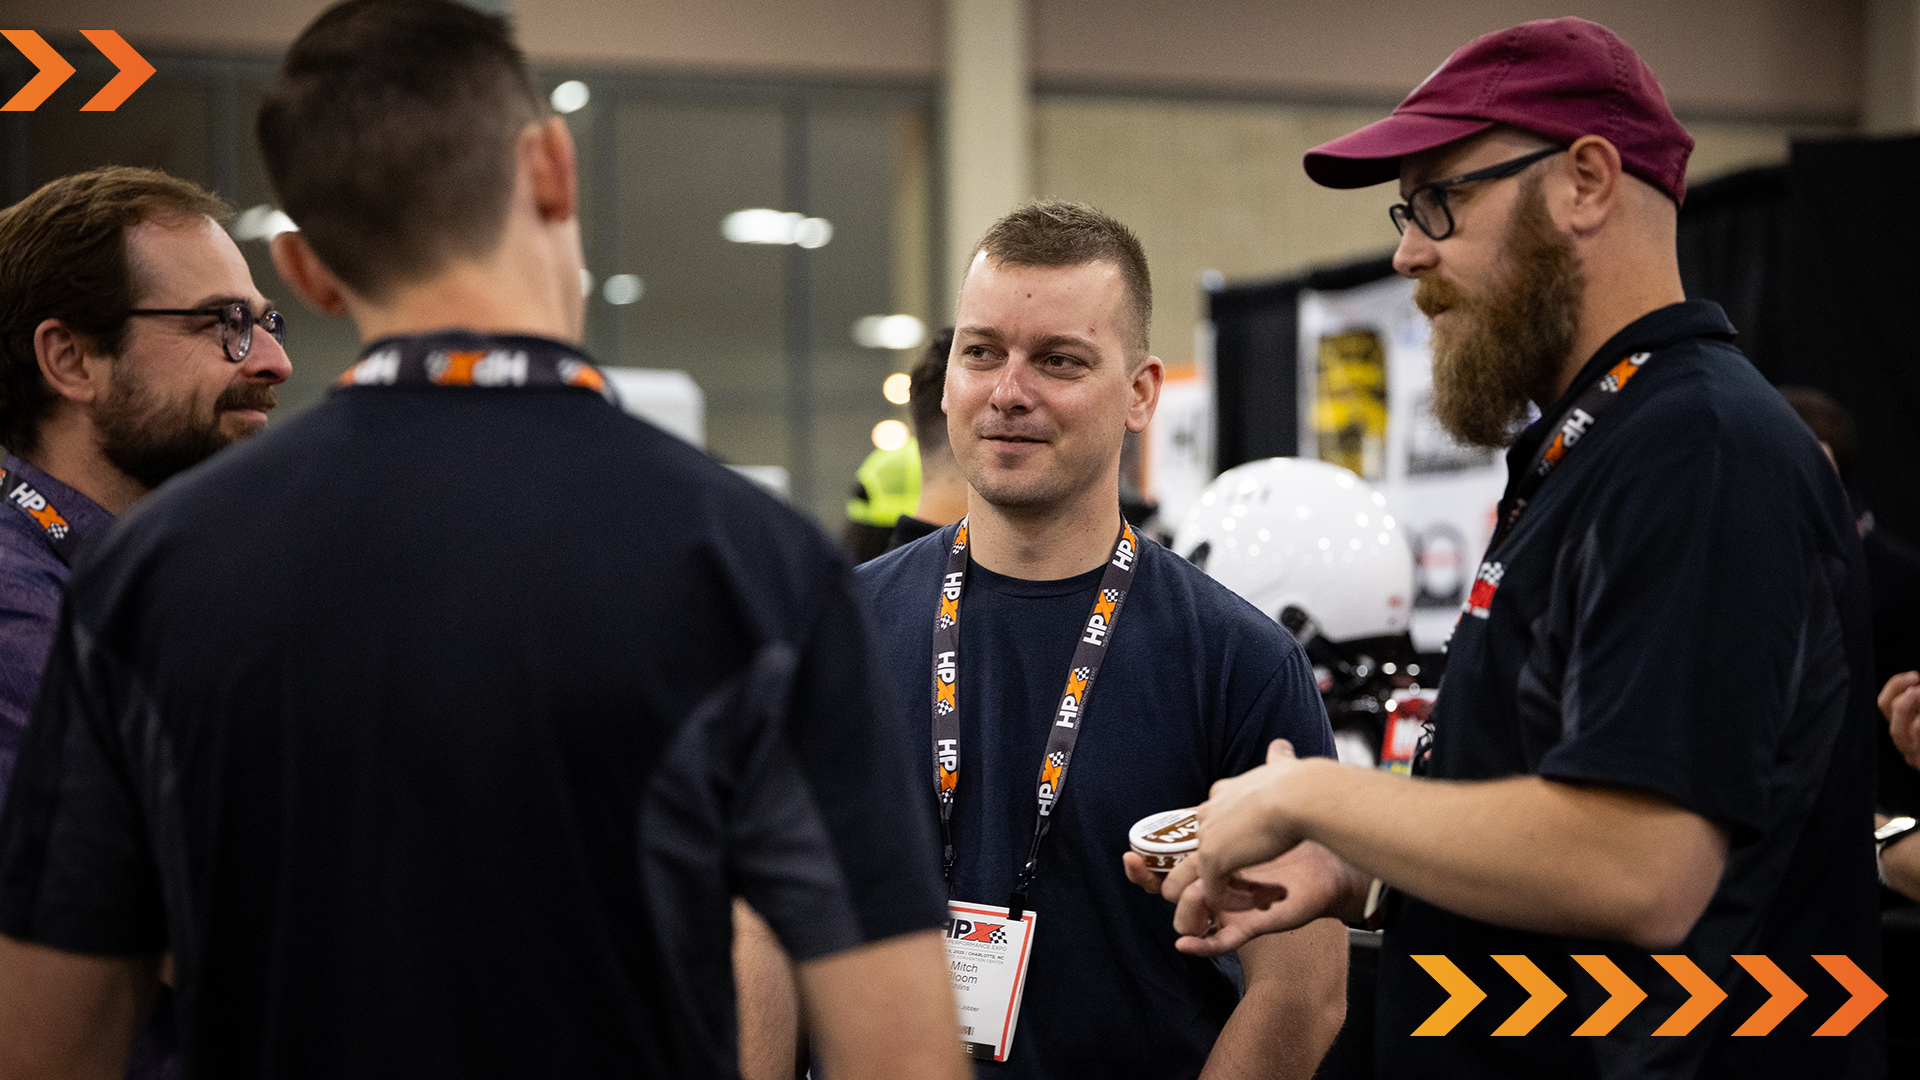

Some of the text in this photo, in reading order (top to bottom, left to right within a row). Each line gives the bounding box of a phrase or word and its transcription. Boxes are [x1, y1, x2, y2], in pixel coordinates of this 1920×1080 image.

[1544, 408, 1595, 466] HPX
[9, 482, 69, 530] HPX
[941, 572, 963, 623] HPX
[1082, 590, 1116, 646] HPX
[937, 651, 956, 710] HPX
[1055, 669, 1088, 729] HPX
[1076, 680, 1093, 717] PERFORMANCE
[938, 739, 958, 792] HPX
[1038, 754, 1063, 817] HPX
[947, 940, 990, 950] PERFORMANCE
[950, 961, 978, 973] Mitch
